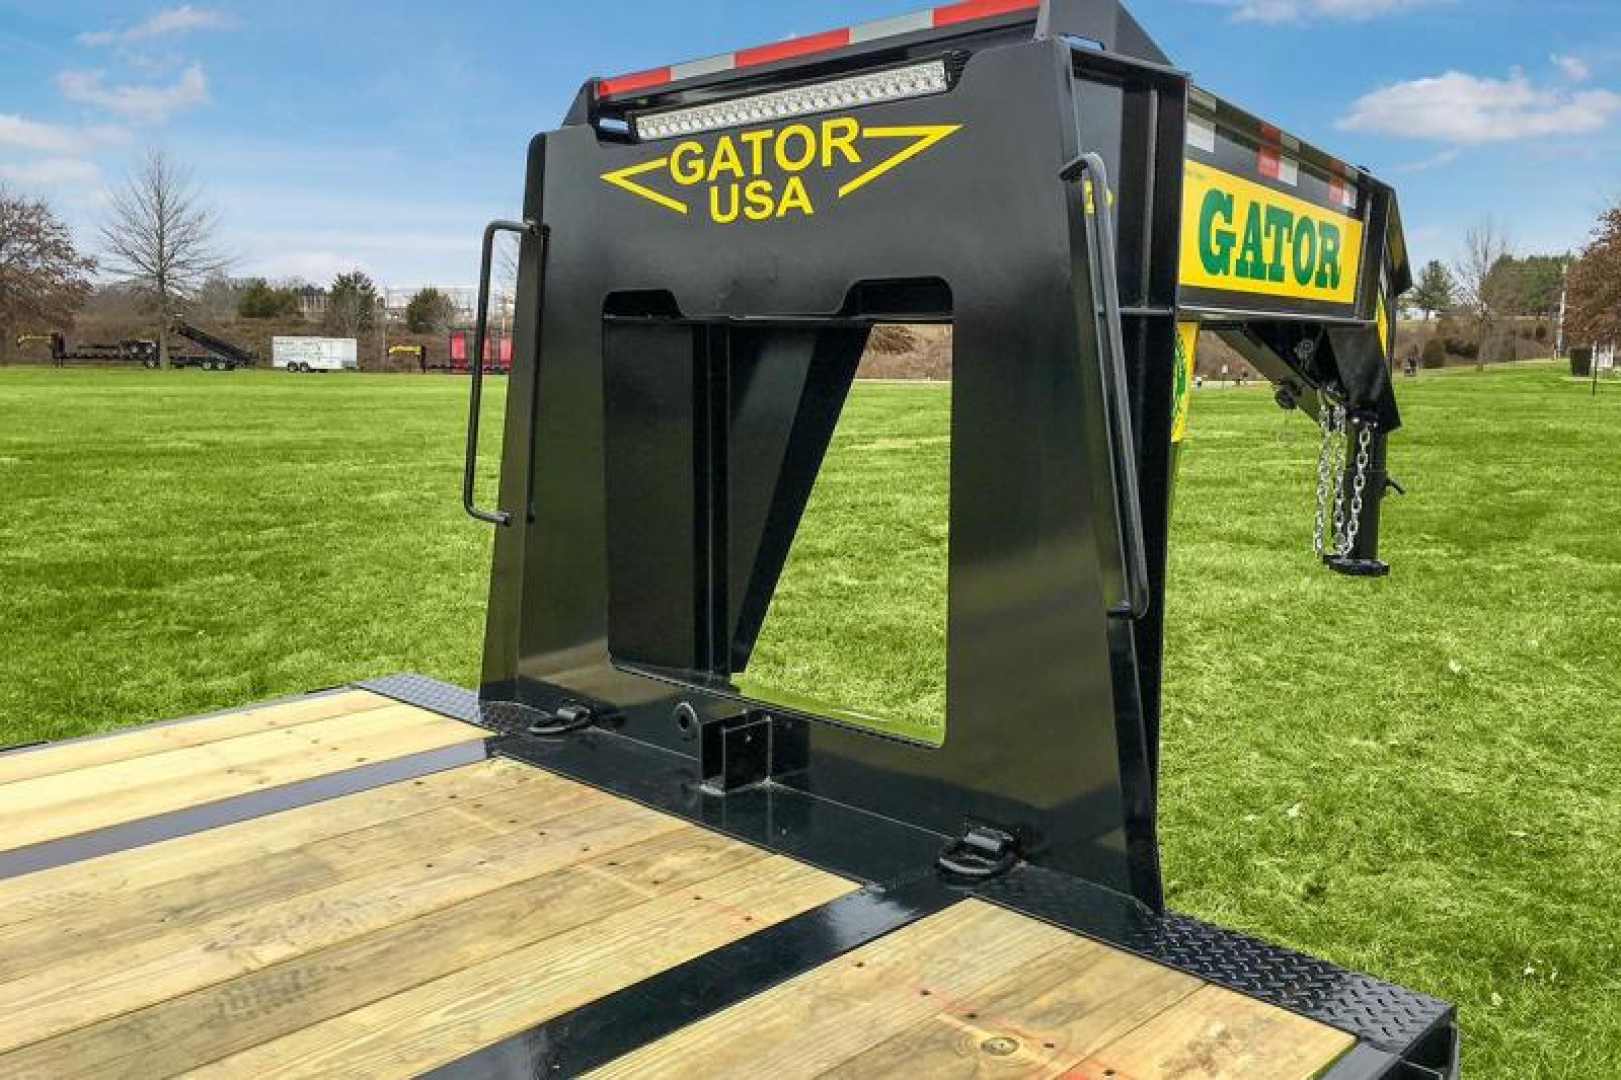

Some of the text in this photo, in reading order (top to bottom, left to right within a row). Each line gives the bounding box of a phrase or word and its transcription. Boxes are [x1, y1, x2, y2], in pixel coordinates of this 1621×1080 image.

[669, 117, 862, 186] GATOR
[709, 175, 814, 224] USA
[1199, 187, 1341, 290] GATOR
